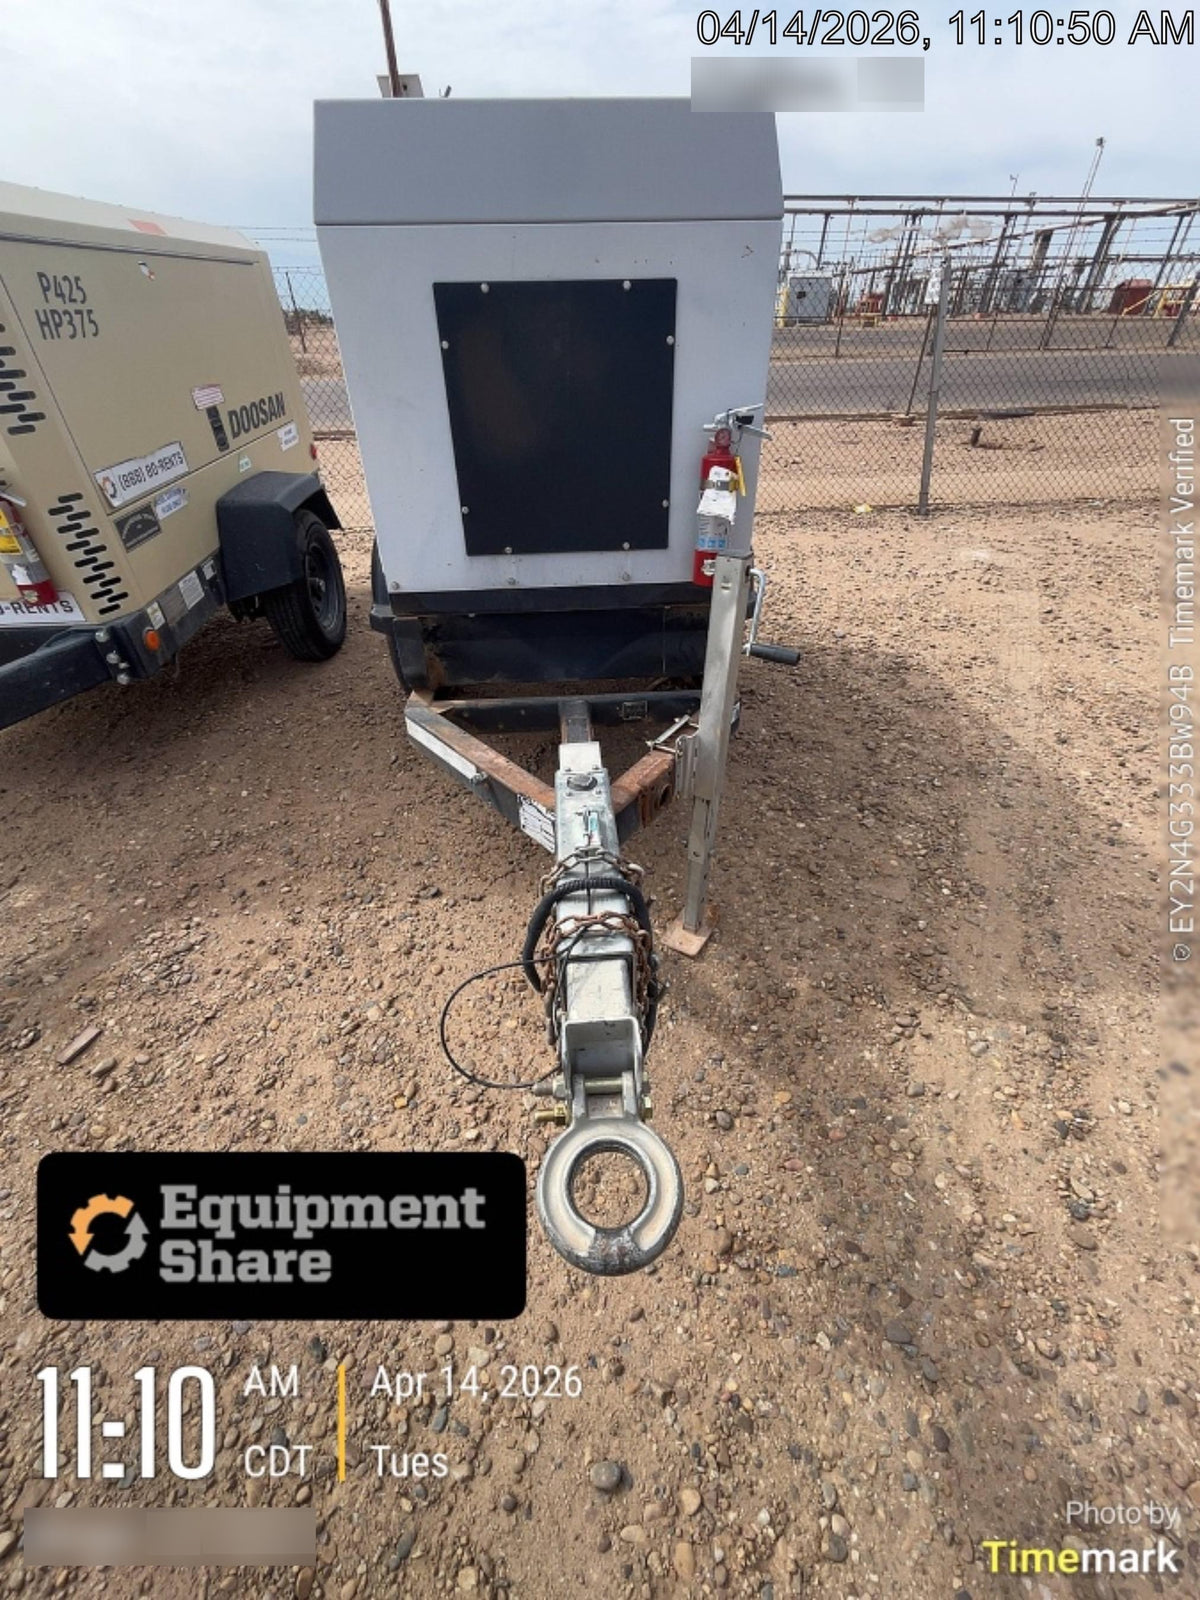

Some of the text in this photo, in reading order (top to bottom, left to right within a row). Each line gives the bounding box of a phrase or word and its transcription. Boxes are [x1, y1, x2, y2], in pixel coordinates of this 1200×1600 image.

[36, 271, 88, 305] P425
[34, 308, 99, 341] HP375
[227, 391, 287, 440] DOOSAN
